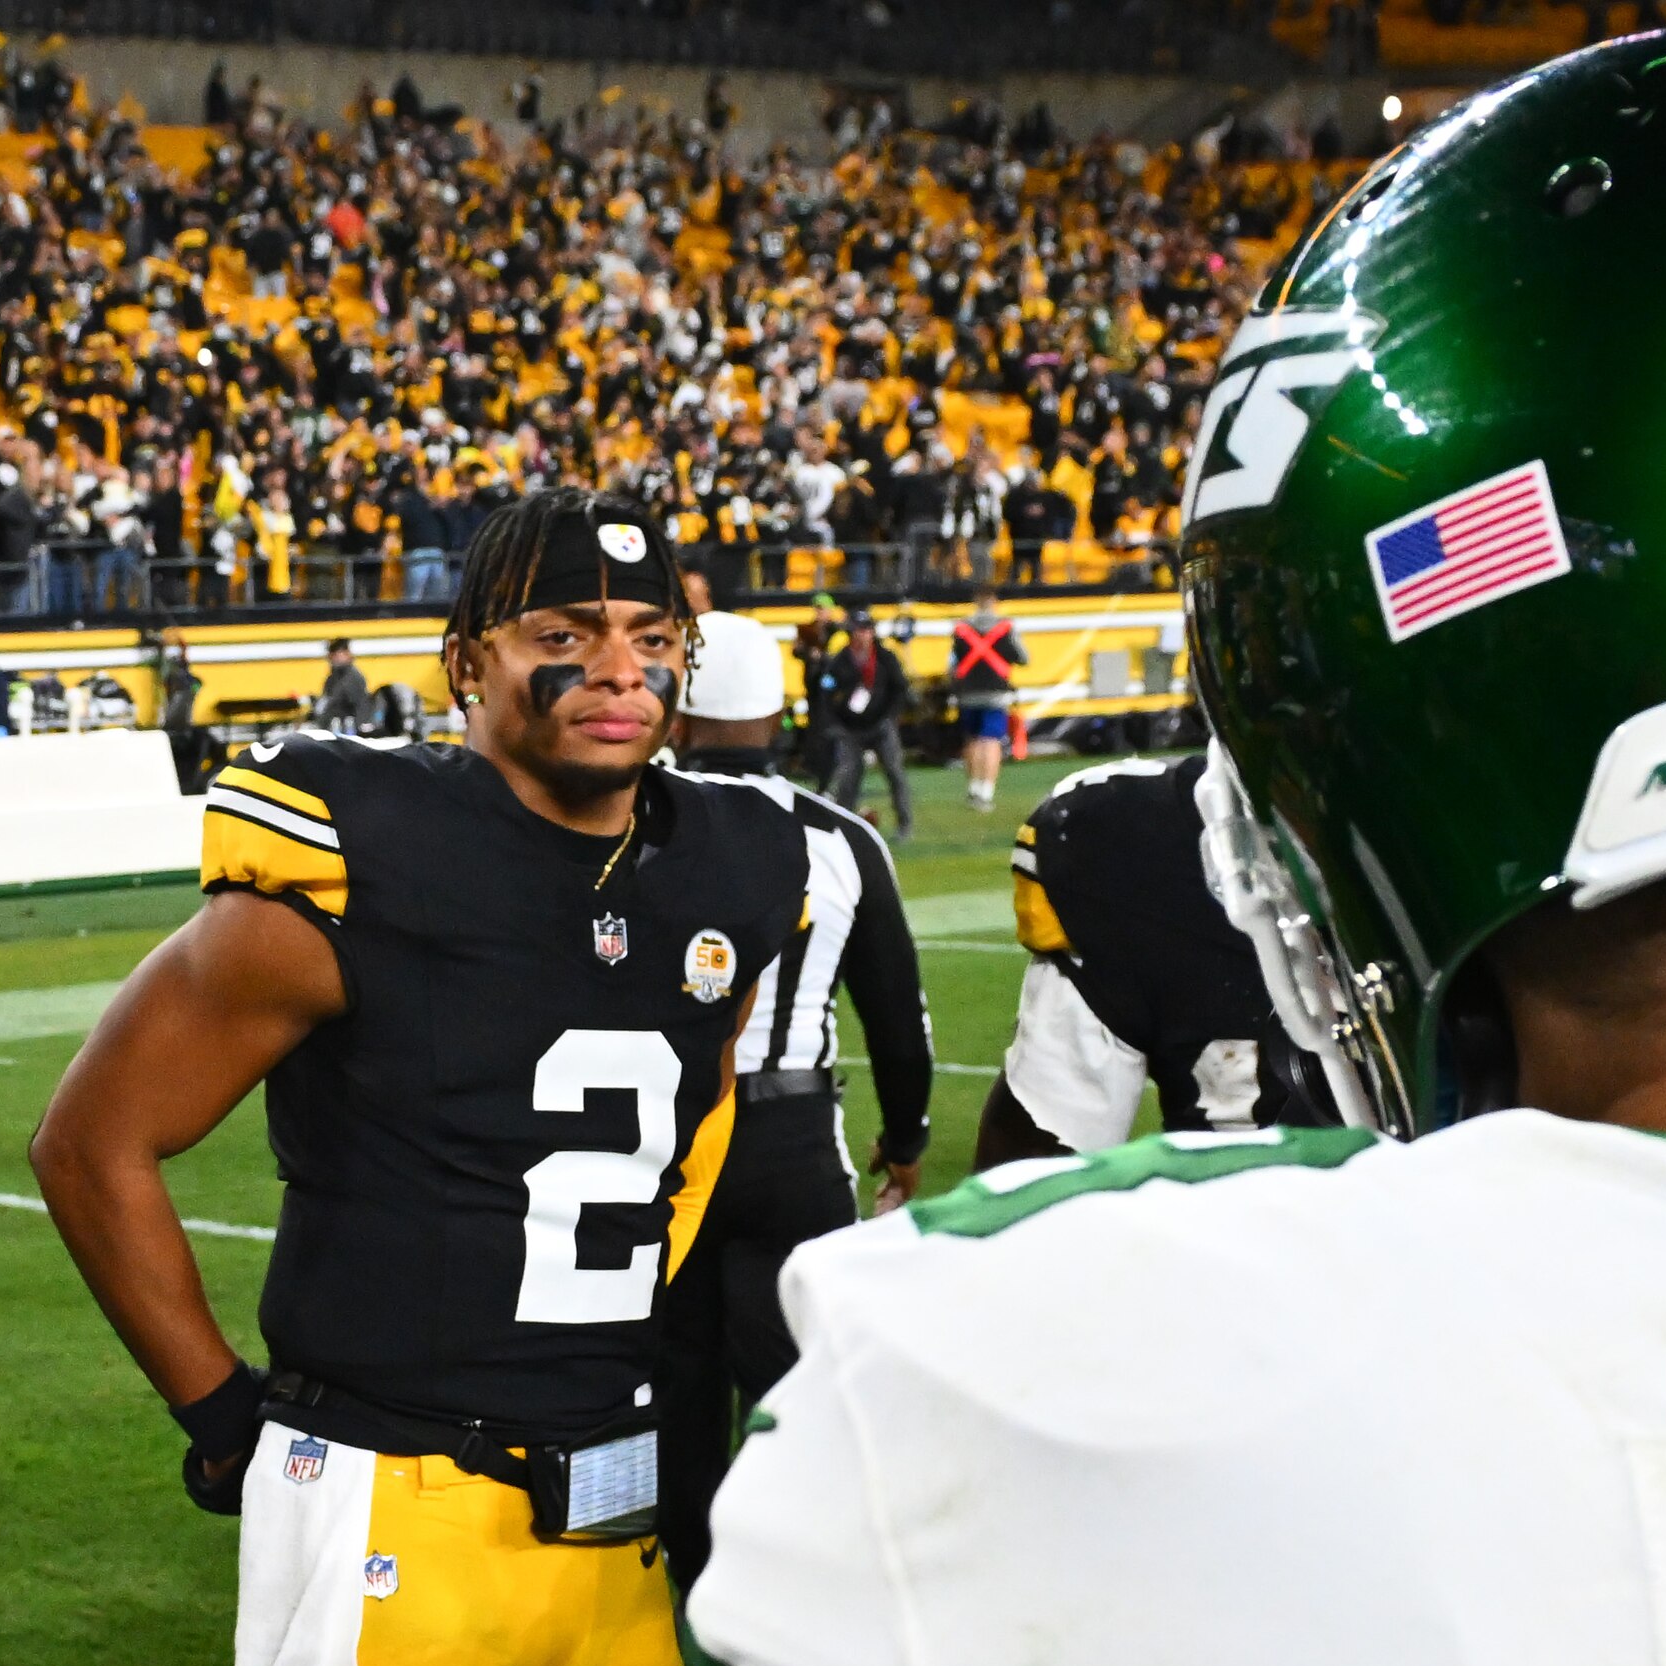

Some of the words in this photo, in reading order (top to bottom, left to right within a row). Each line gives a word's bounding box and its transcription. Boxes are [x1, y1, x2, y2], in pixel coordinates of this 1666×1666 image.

[515, 1029, 682, 1324] 2
[289, 1456, 319, 1480] NFL
[365, 1572, 392, 1589] NFL
